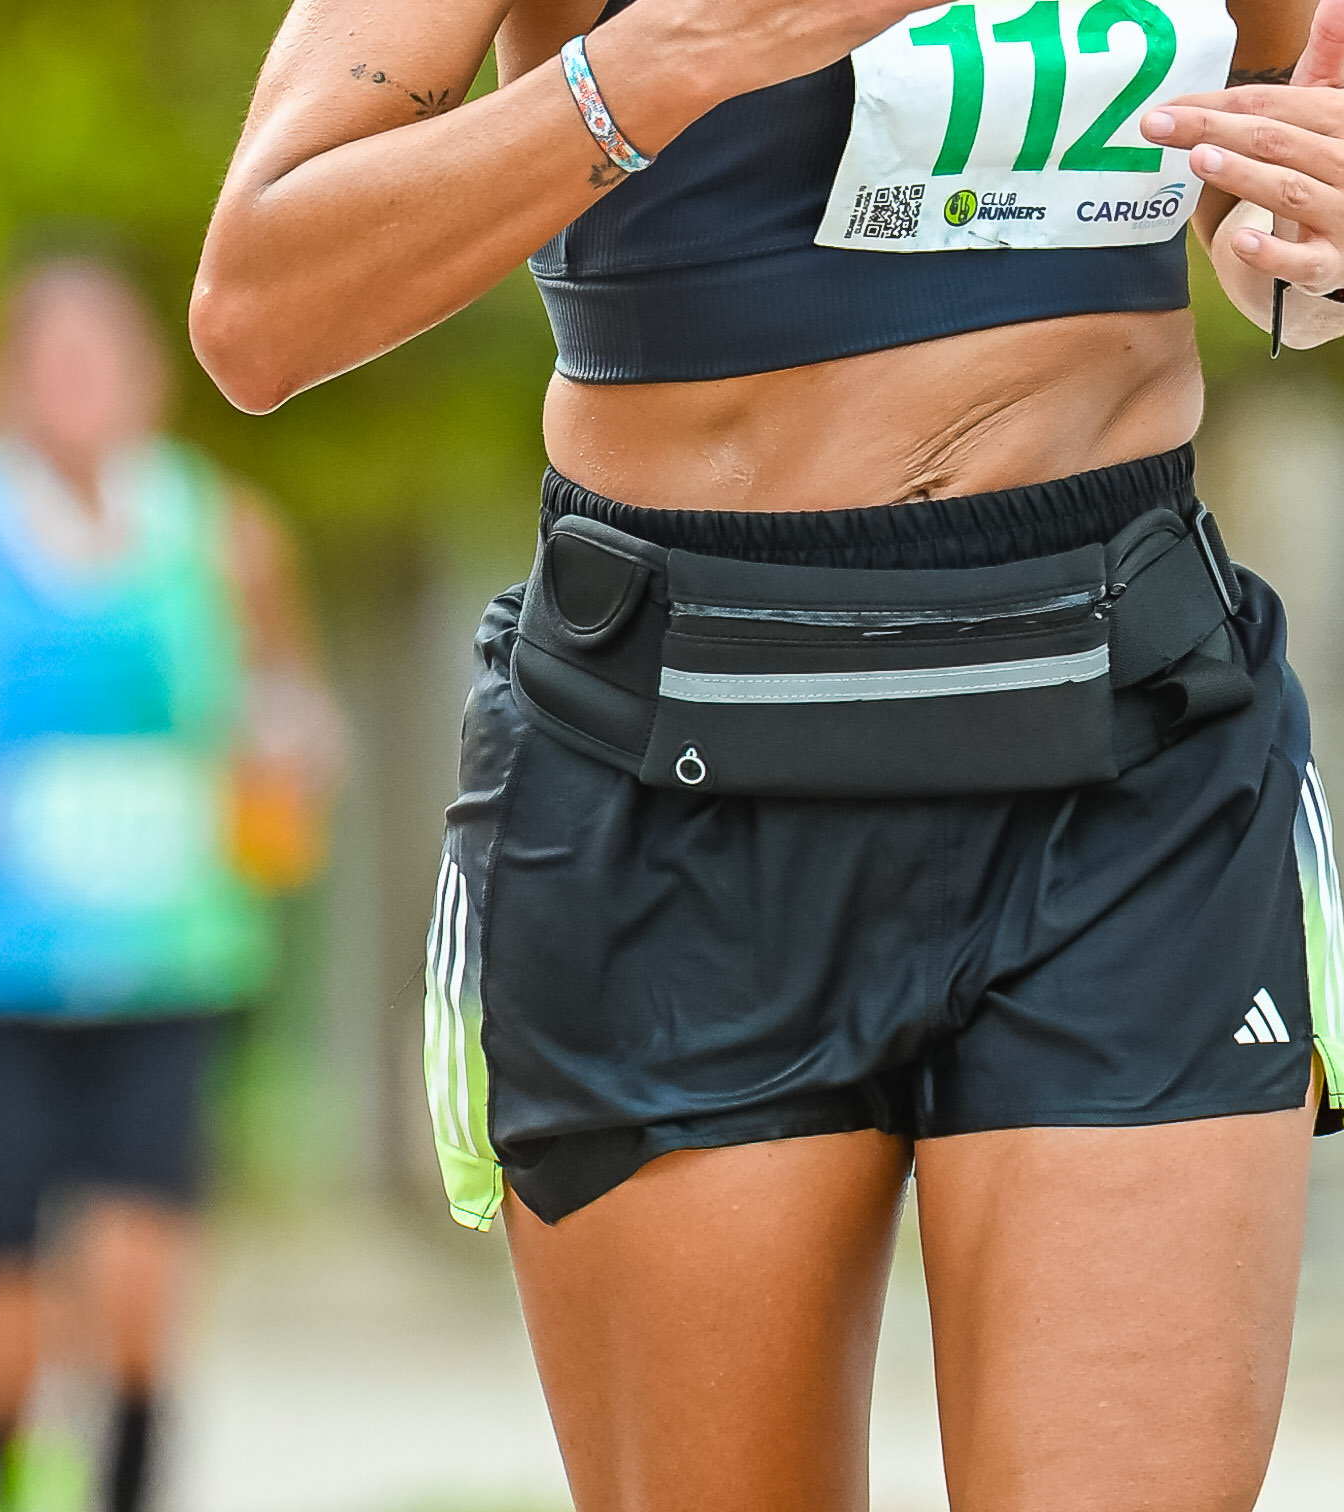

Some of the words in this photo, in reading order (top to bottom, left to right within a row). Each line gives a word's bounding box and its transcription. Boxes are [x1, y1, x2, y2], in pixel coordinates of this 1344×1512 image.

[981, 192, 1017, 206] CLUB
[977, 206, 1046, 220] RUNNER'S
[1076, 197, 1179, 222] CARUSO
